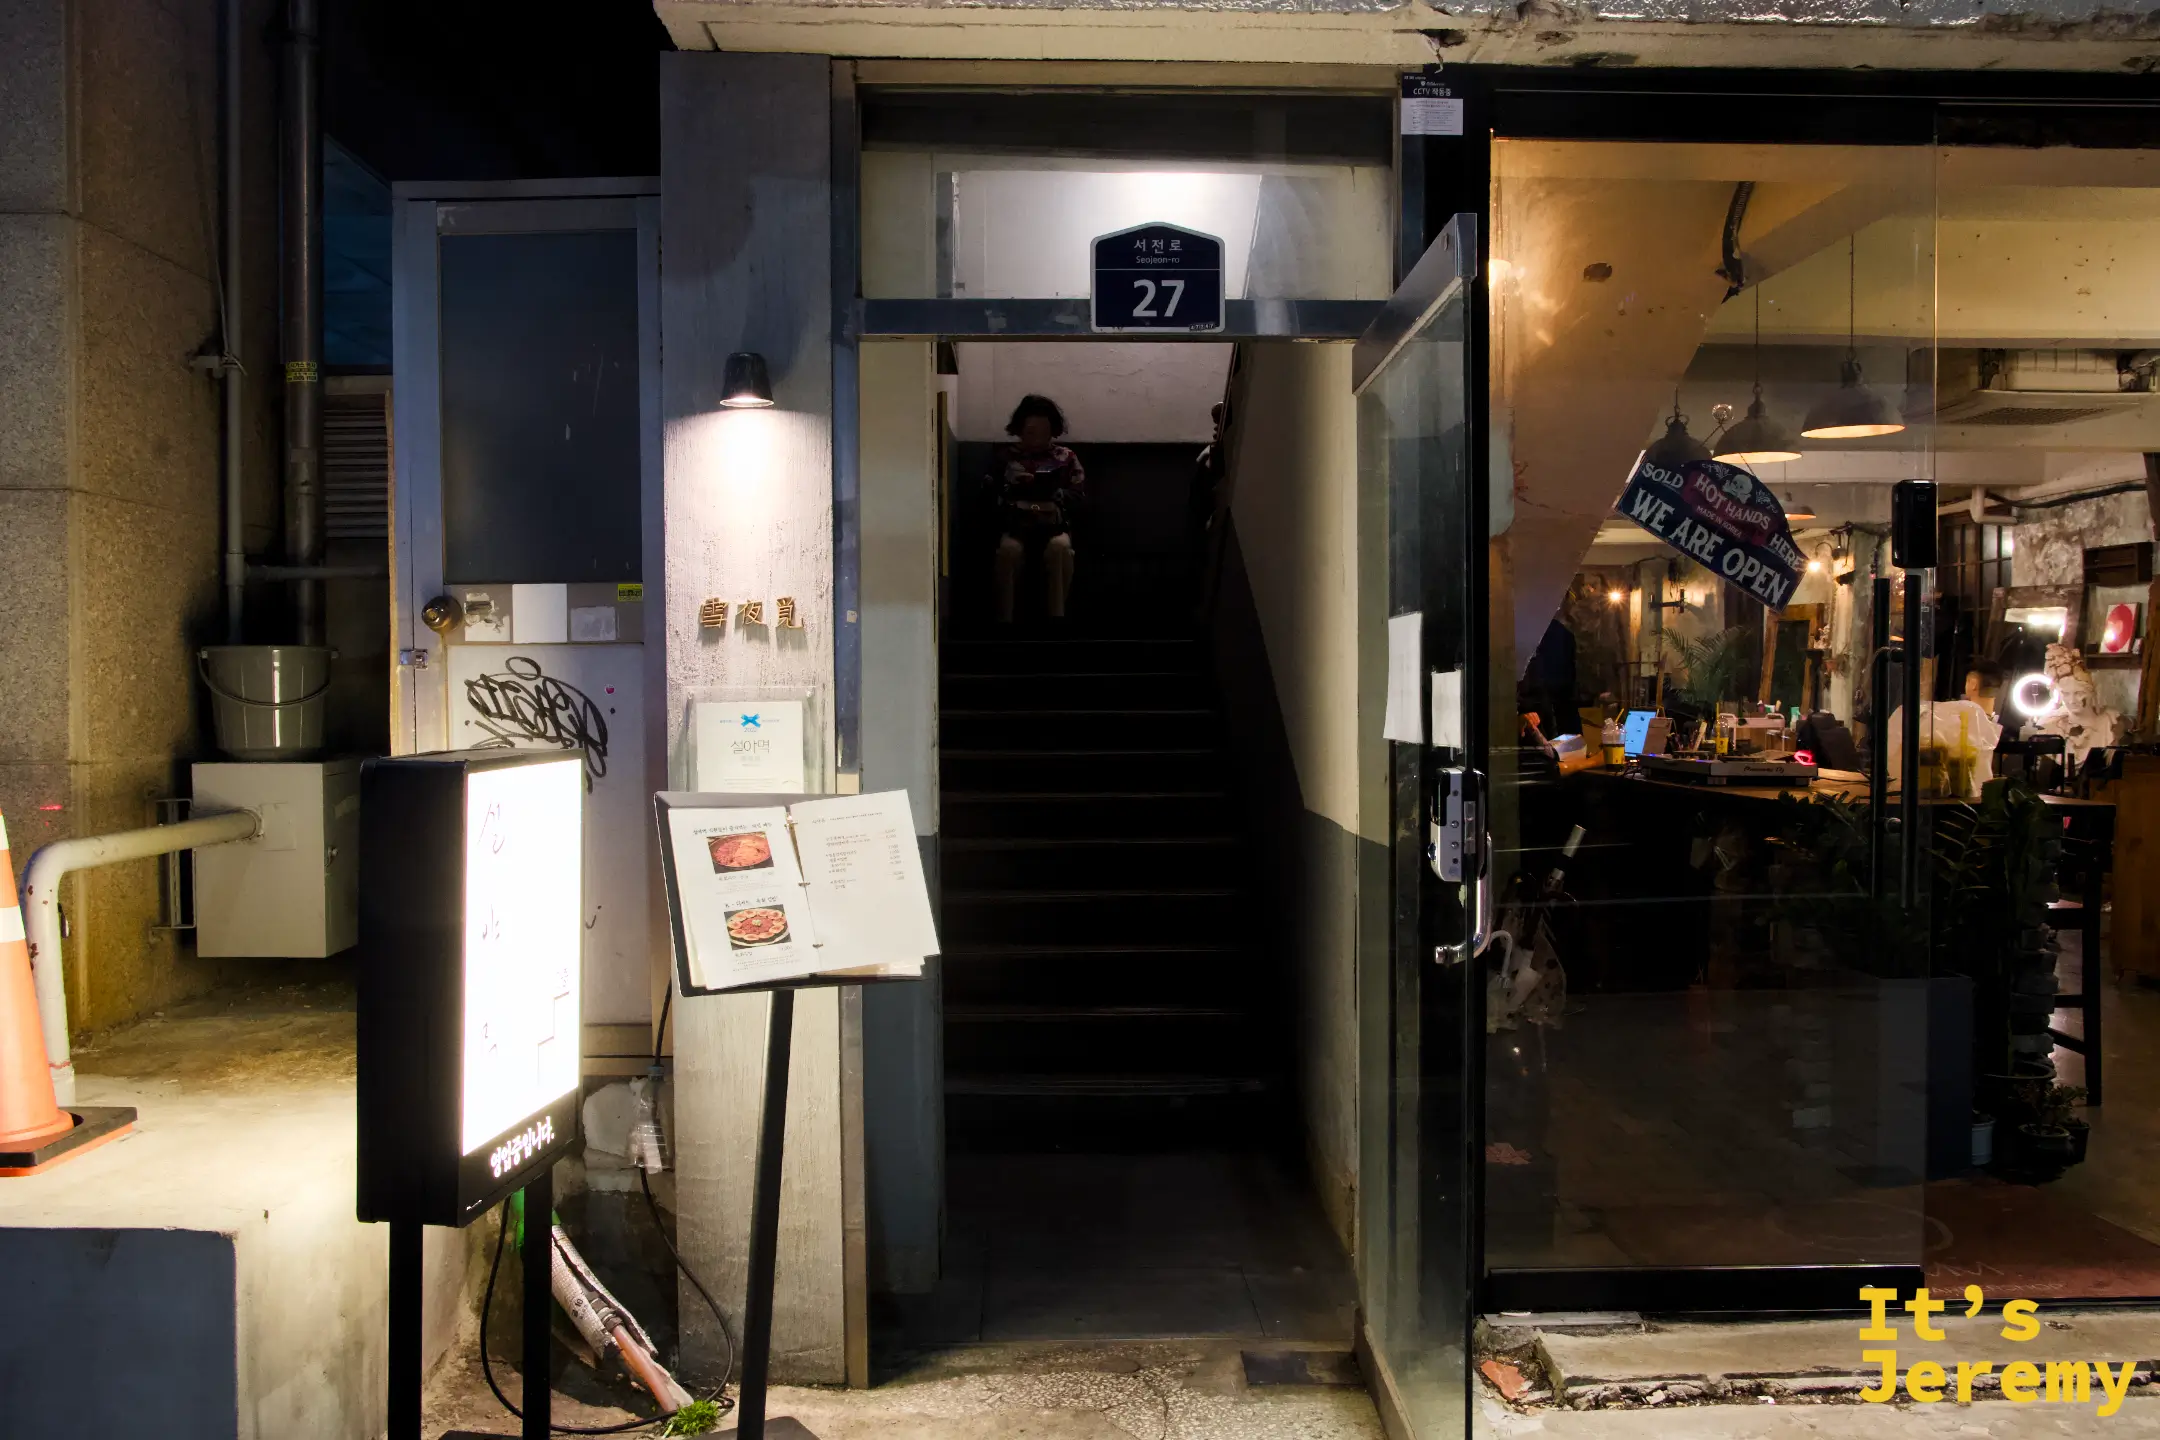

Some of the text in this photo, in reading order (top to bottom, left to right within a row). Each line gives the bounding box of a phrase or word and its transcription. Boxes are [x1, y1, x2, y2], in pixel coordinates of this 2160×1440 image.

[1134, 239, 1183, 254] 서전로
[1136, 256, 1180, 265] Seojeon-ro
[1132, 279, 1185, 317] 27
[1641, 462, 1684, 489] SOLD
[1694, 474, 1771, 531] HOT HANDS
[1696, 505, 1715, 521] MADE
[1721, 520, 1743, 538] KOREA
[1630, 487, 1791, 606] WE ARE OPEN
[1769, 533, 1806, 571] HERE
[490, 1115, 555, 1178] 영업중입니다.
